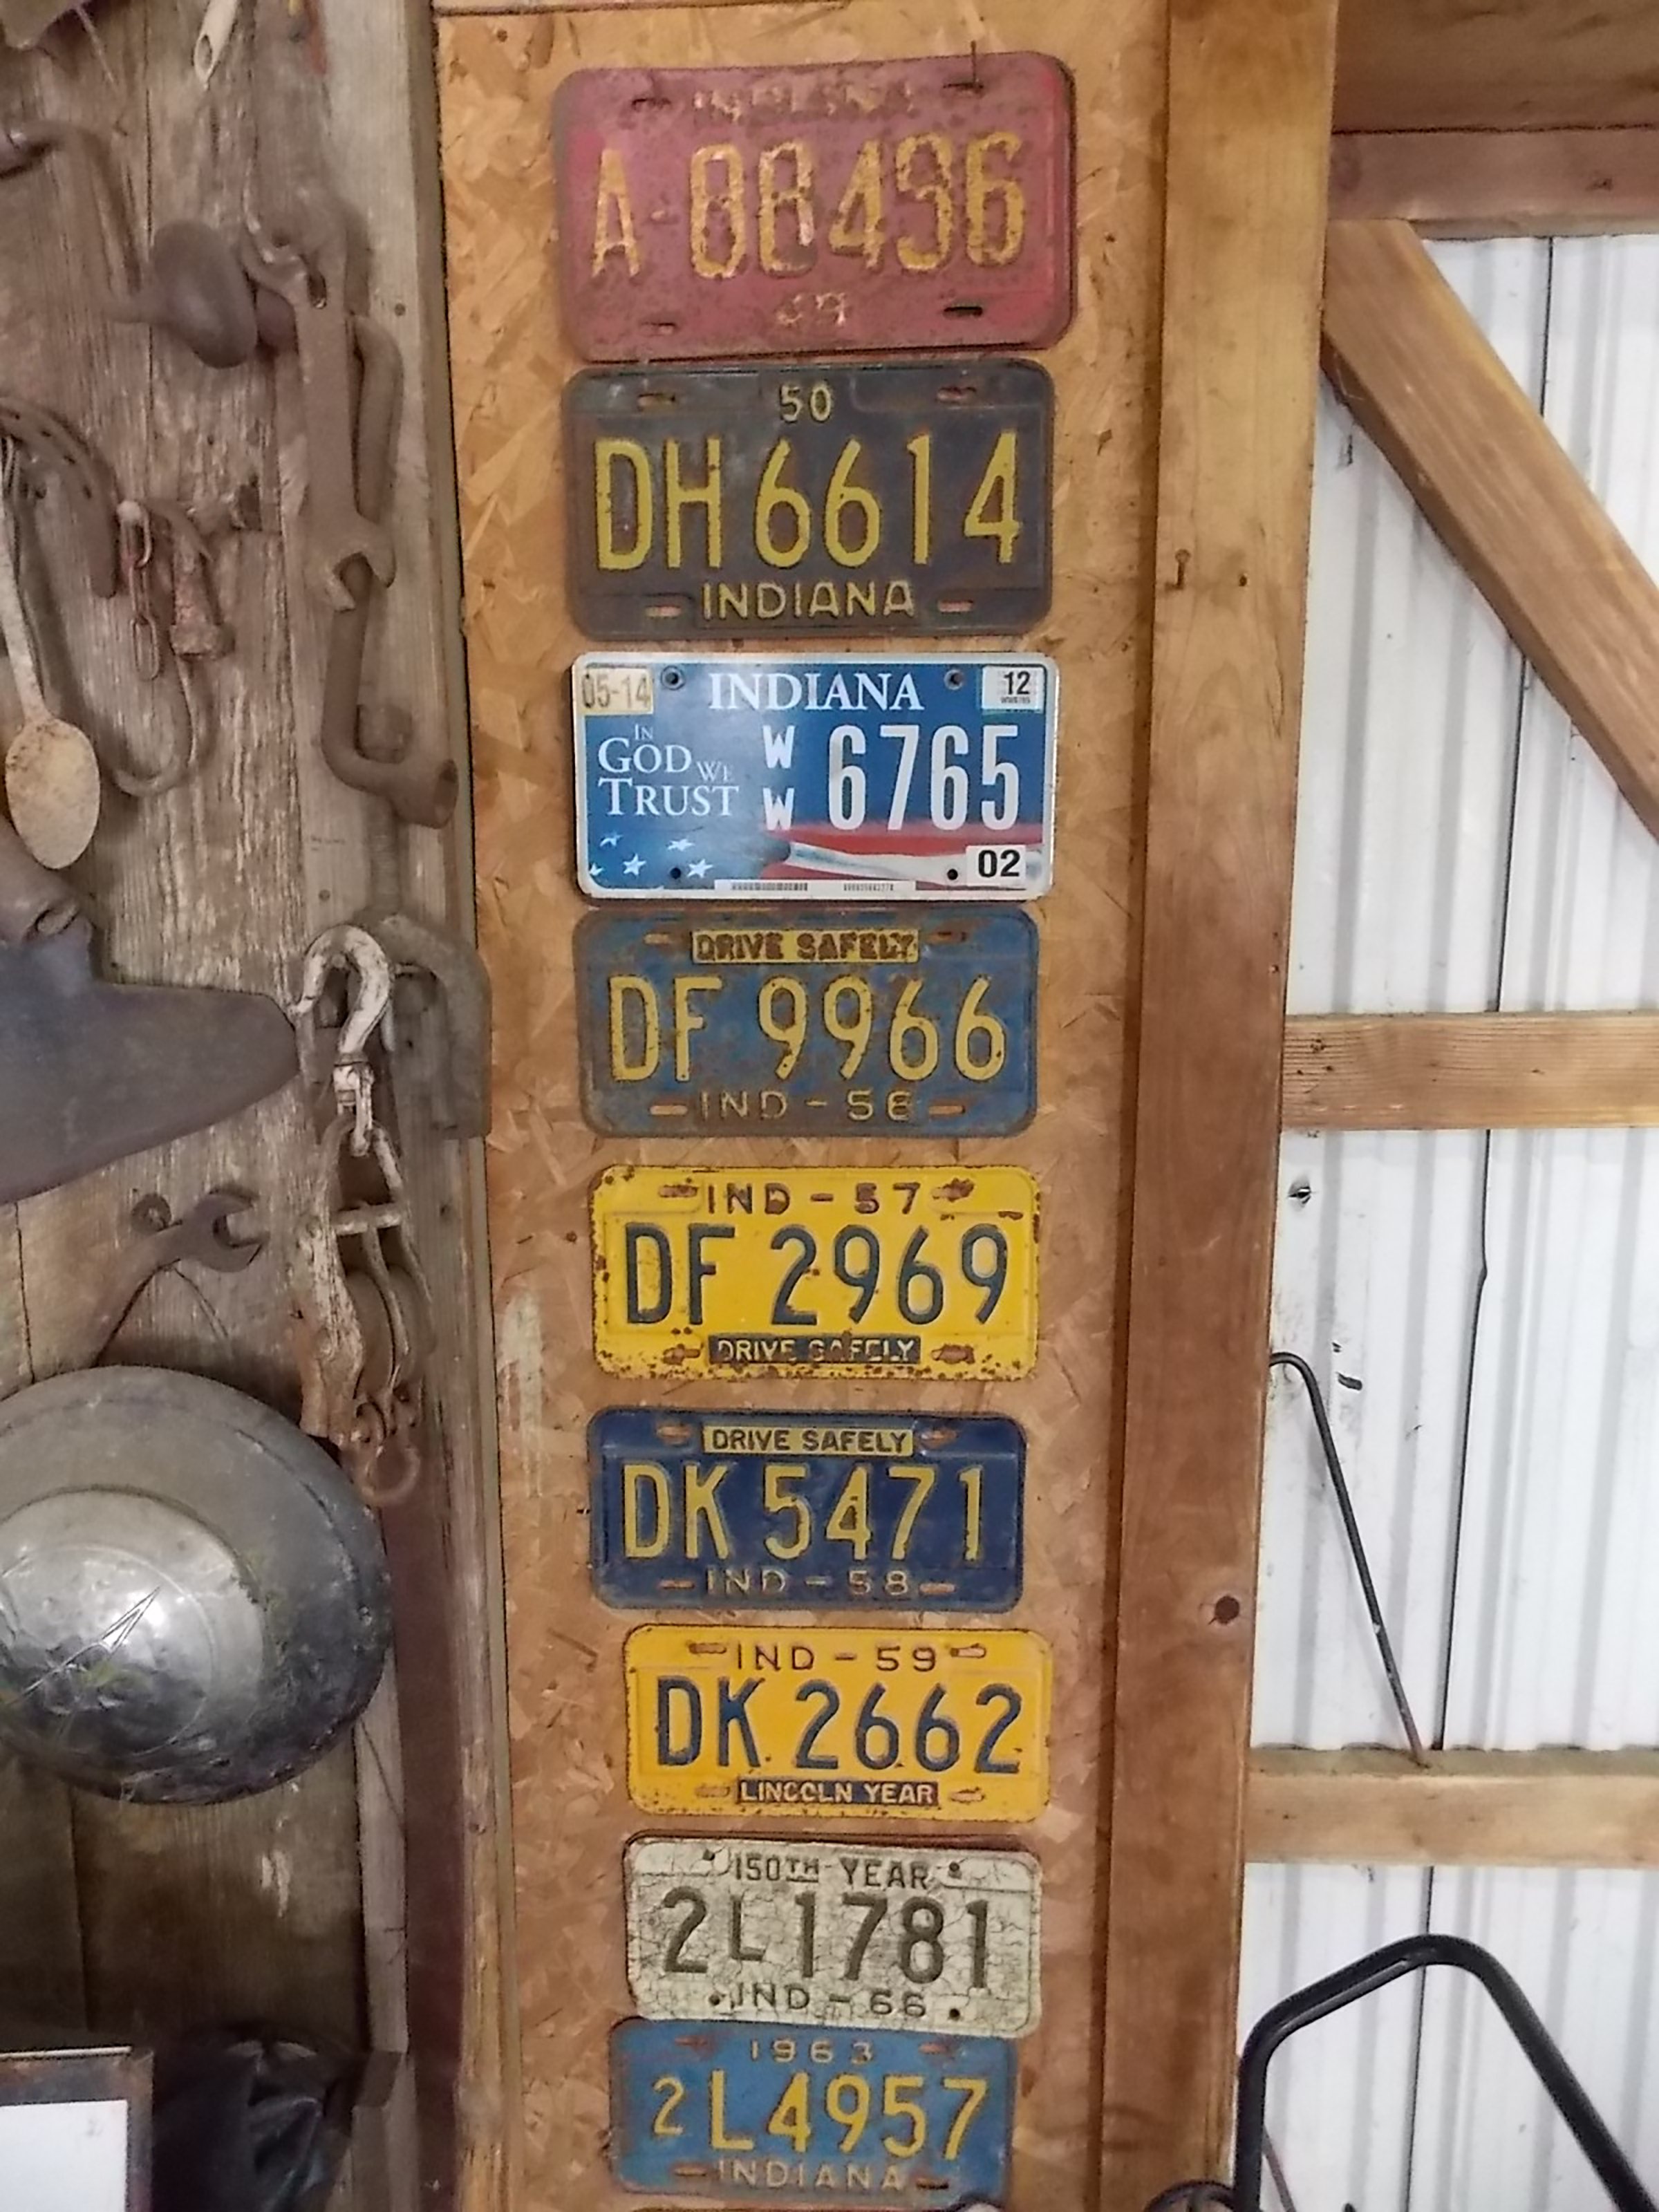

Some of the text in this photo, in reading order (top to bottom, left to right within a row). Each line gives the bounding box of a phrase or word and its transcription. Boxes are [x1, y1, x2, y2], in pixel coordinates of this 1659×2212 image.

[780, 383, 832, 421] 50
[594, 430, 1020, 570] DH 6614
[703, 580, 916, 619] INDIANA
[709, 672, 924, 711] INDIANA
[1004, 671, 1030, 695] 12
[635, 724, 653, 740] IN
[598, 737, 692, 774] GOD
[829, 724, 1020, 831] 6765
[598, 777, 740, 816] TRUST
[978, 850, 1020, 877] 02
[697, 932, 917, 961] DRIVE SAFELY
[608, 975, 1006, 1081] DF 9966
[707, 1183, 791, 1215] IND
[625, 1222, 1009, 1326] DF 2969
[718, 1339, 796, 1362] DRIVE
[711, 1430, 908, 1452] DRIVE SAFELY
[624, 1464, 983, 1562] DK 5471
[737, 1644, 816, 1671] IND
[656, 1676, 1022, 1774] DK 2662
[741, 1781, 934, 1805] LINCOLN YEAR
[735, 1857, 928, 1890] 150TH YEAR
[751, 2039, 873, 2065] 1963
[719, 2159, 904, 2191] INDIANA
